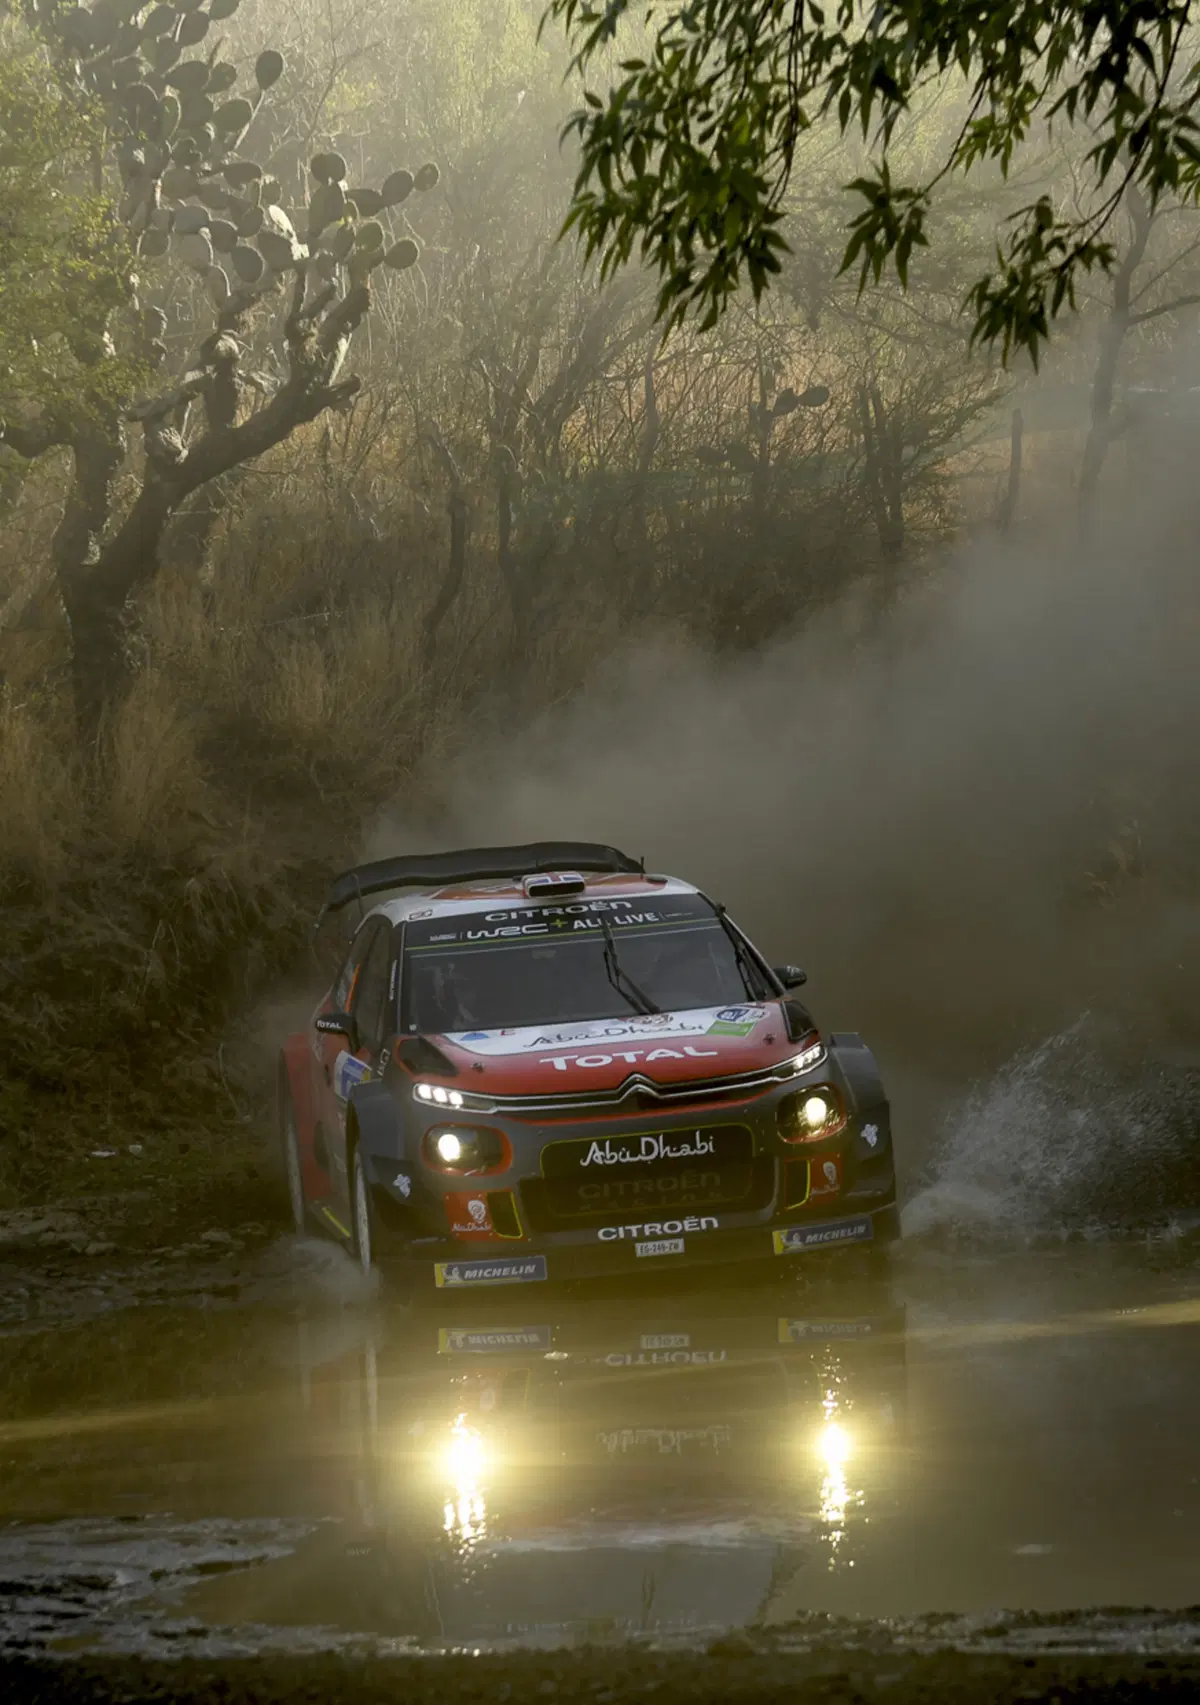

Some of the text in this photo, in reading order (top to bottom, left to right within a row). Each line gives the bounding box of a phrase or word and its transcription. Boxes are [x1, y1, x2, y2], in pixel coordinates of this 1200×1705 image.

[484, 901, 632, 922] CITROËN
[613, 911, 659, 925] LIVE
[316, 1019, 343, 1030] TOTAL
[539, 1046, 719, 1071] TOTAL
[597, 1215, 720, 1241] CITROËN
[804, 1224, 867, 1244] MICHELIN
[464, 1264, 537, 1280] MICHELIN
